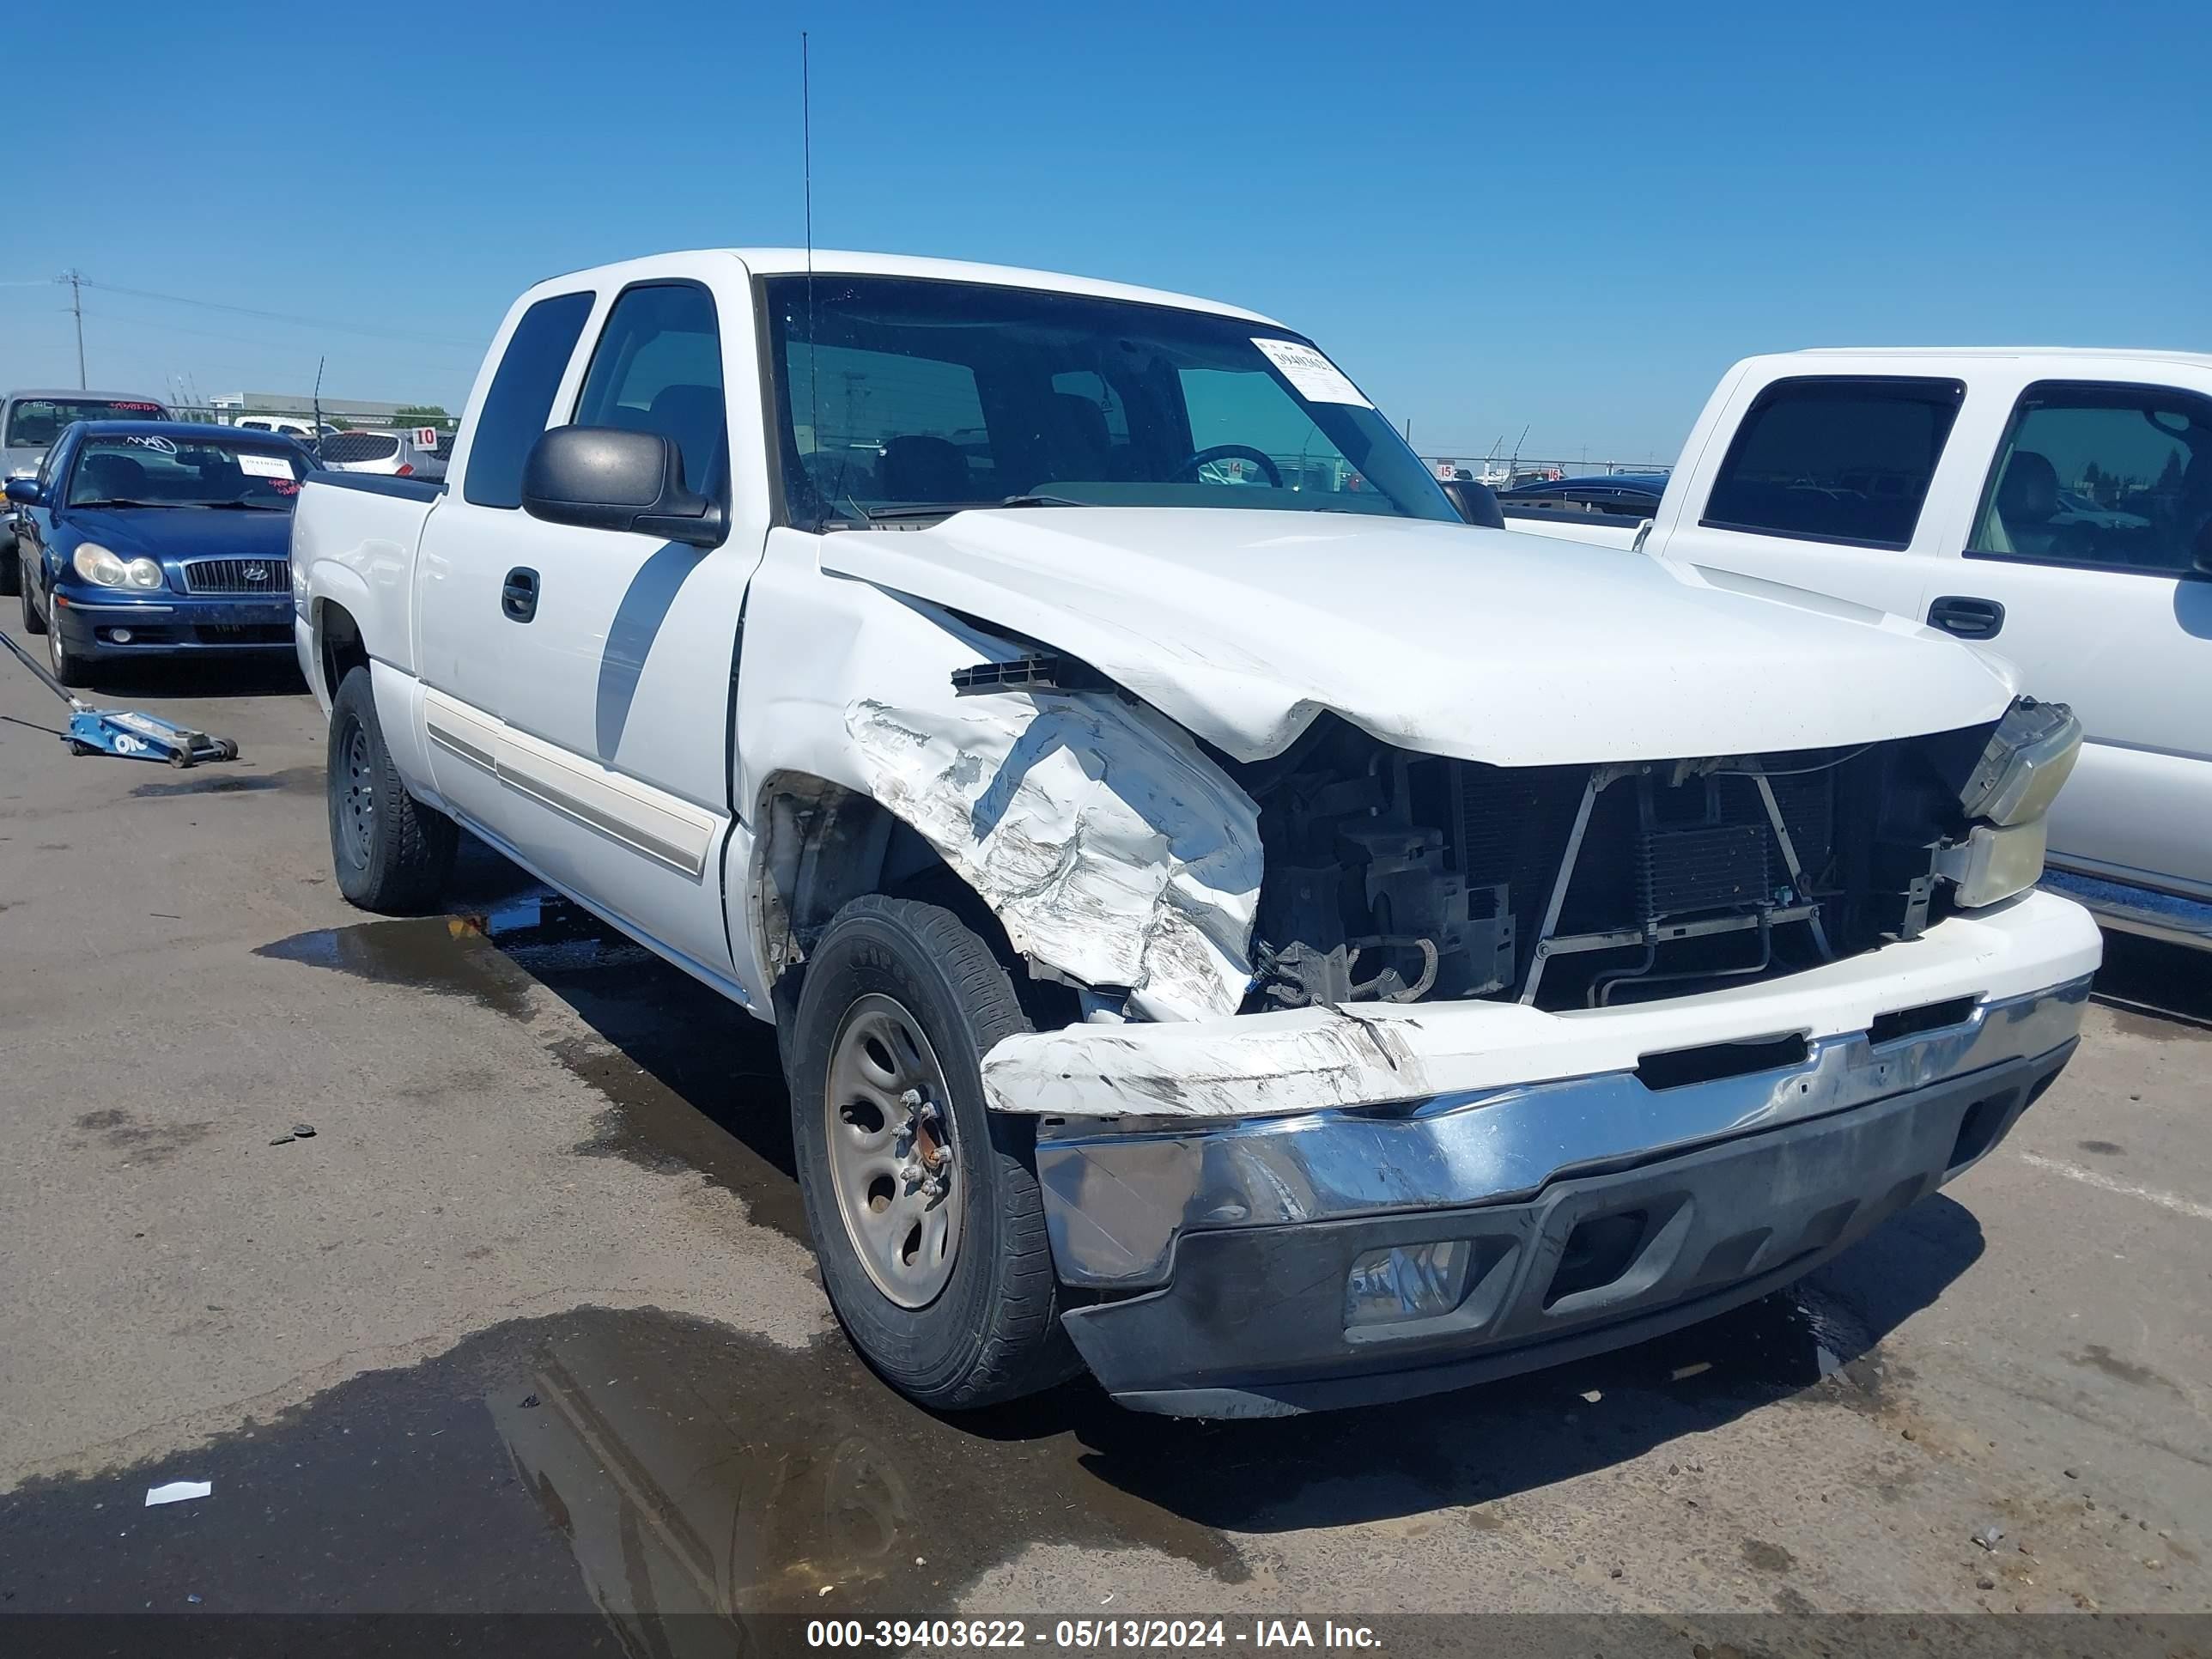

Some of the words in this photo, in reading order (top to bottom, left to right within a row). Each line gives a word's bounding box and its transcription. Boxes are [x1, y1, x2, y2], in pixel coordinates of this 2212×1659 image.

[416, 429, 434, 444] 10
[1230, 462, 1240, 474] 14
[1441, 465, 1451, 477] 15
[1549, 468, 1559, 480] 16
